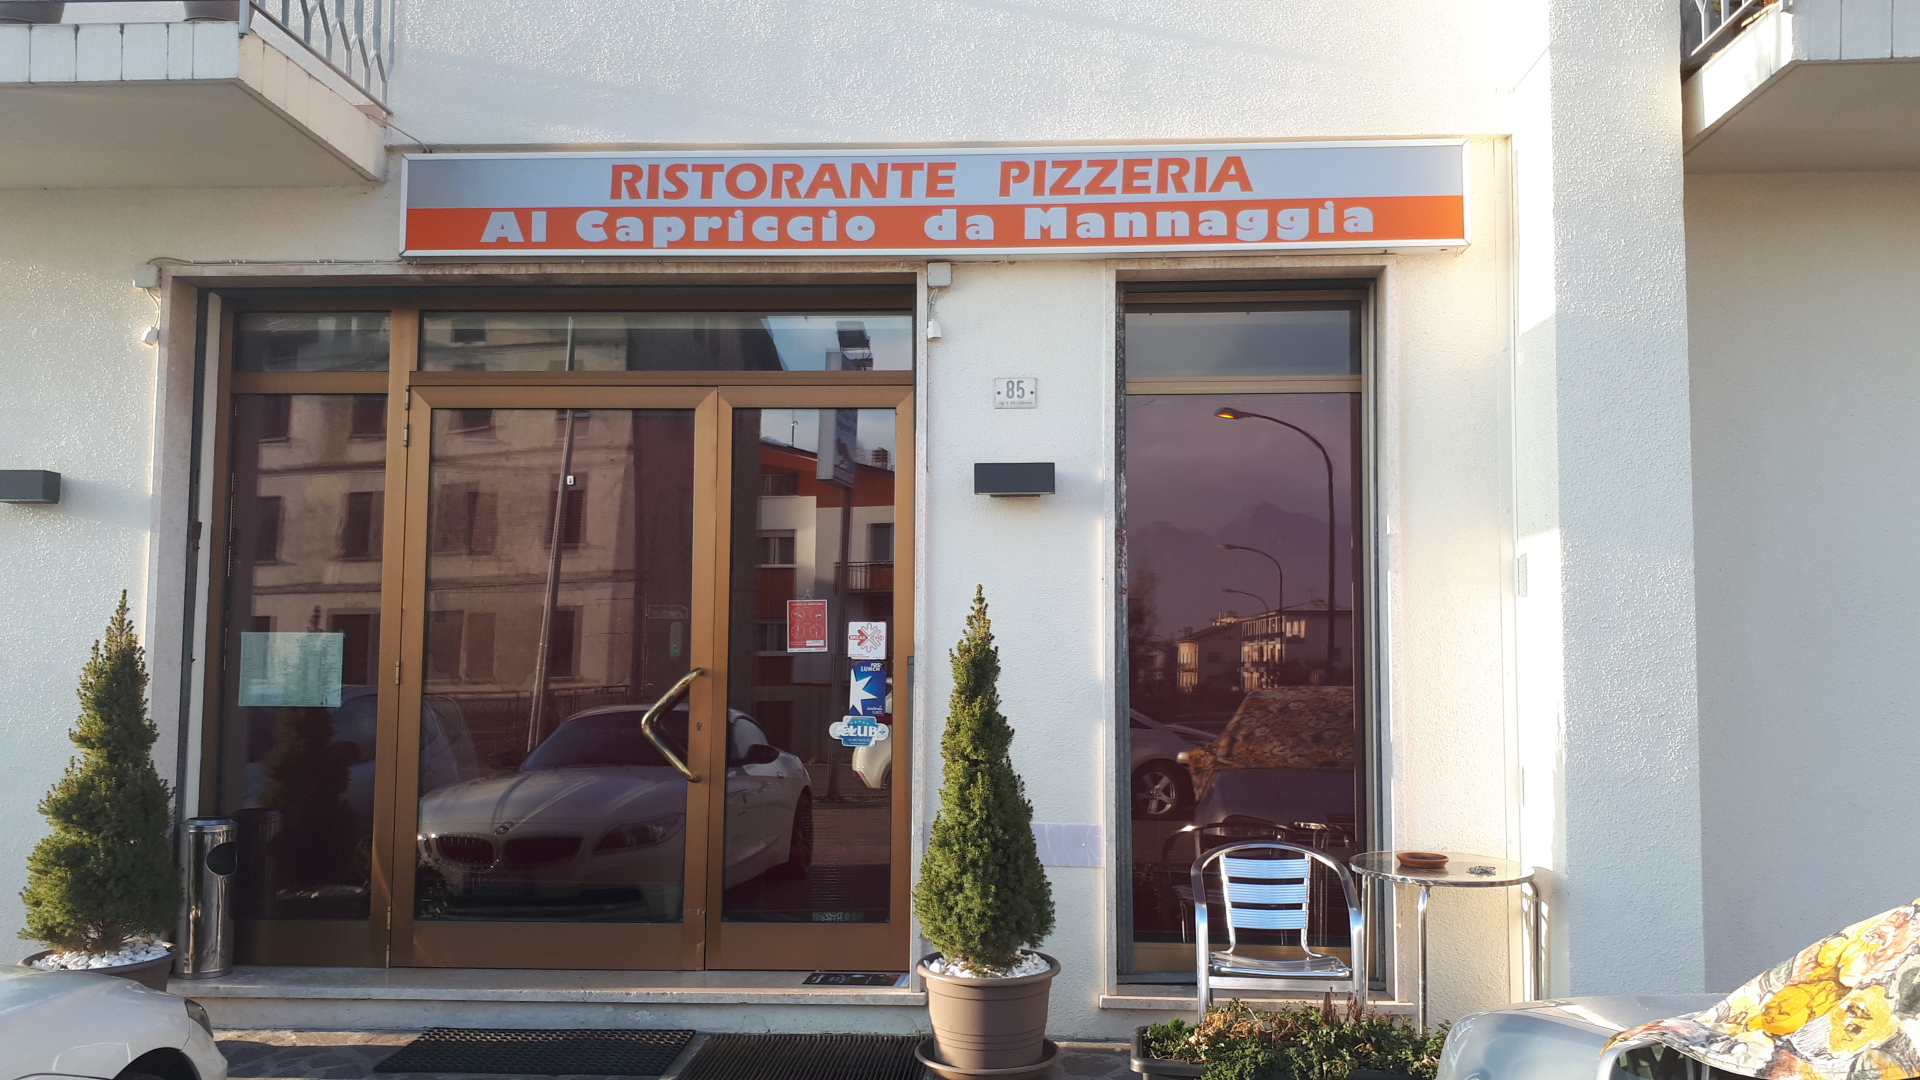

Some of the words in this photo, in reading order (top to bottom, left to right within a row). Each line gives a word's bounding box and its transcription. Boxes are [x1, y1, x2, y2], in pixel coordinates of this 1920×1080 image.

[611, 163, 957, 200] RISTORANTE
[999, 156, 1254, 197] PIZZERIA
[480, 210, 548, 243] Al
[576, 209, 877, 249] Capriccio
[923, 208, 995, 241] da
[1024, 200, 1375, 241] Mannaggia
[1006, 380, 1025, 400] 85
